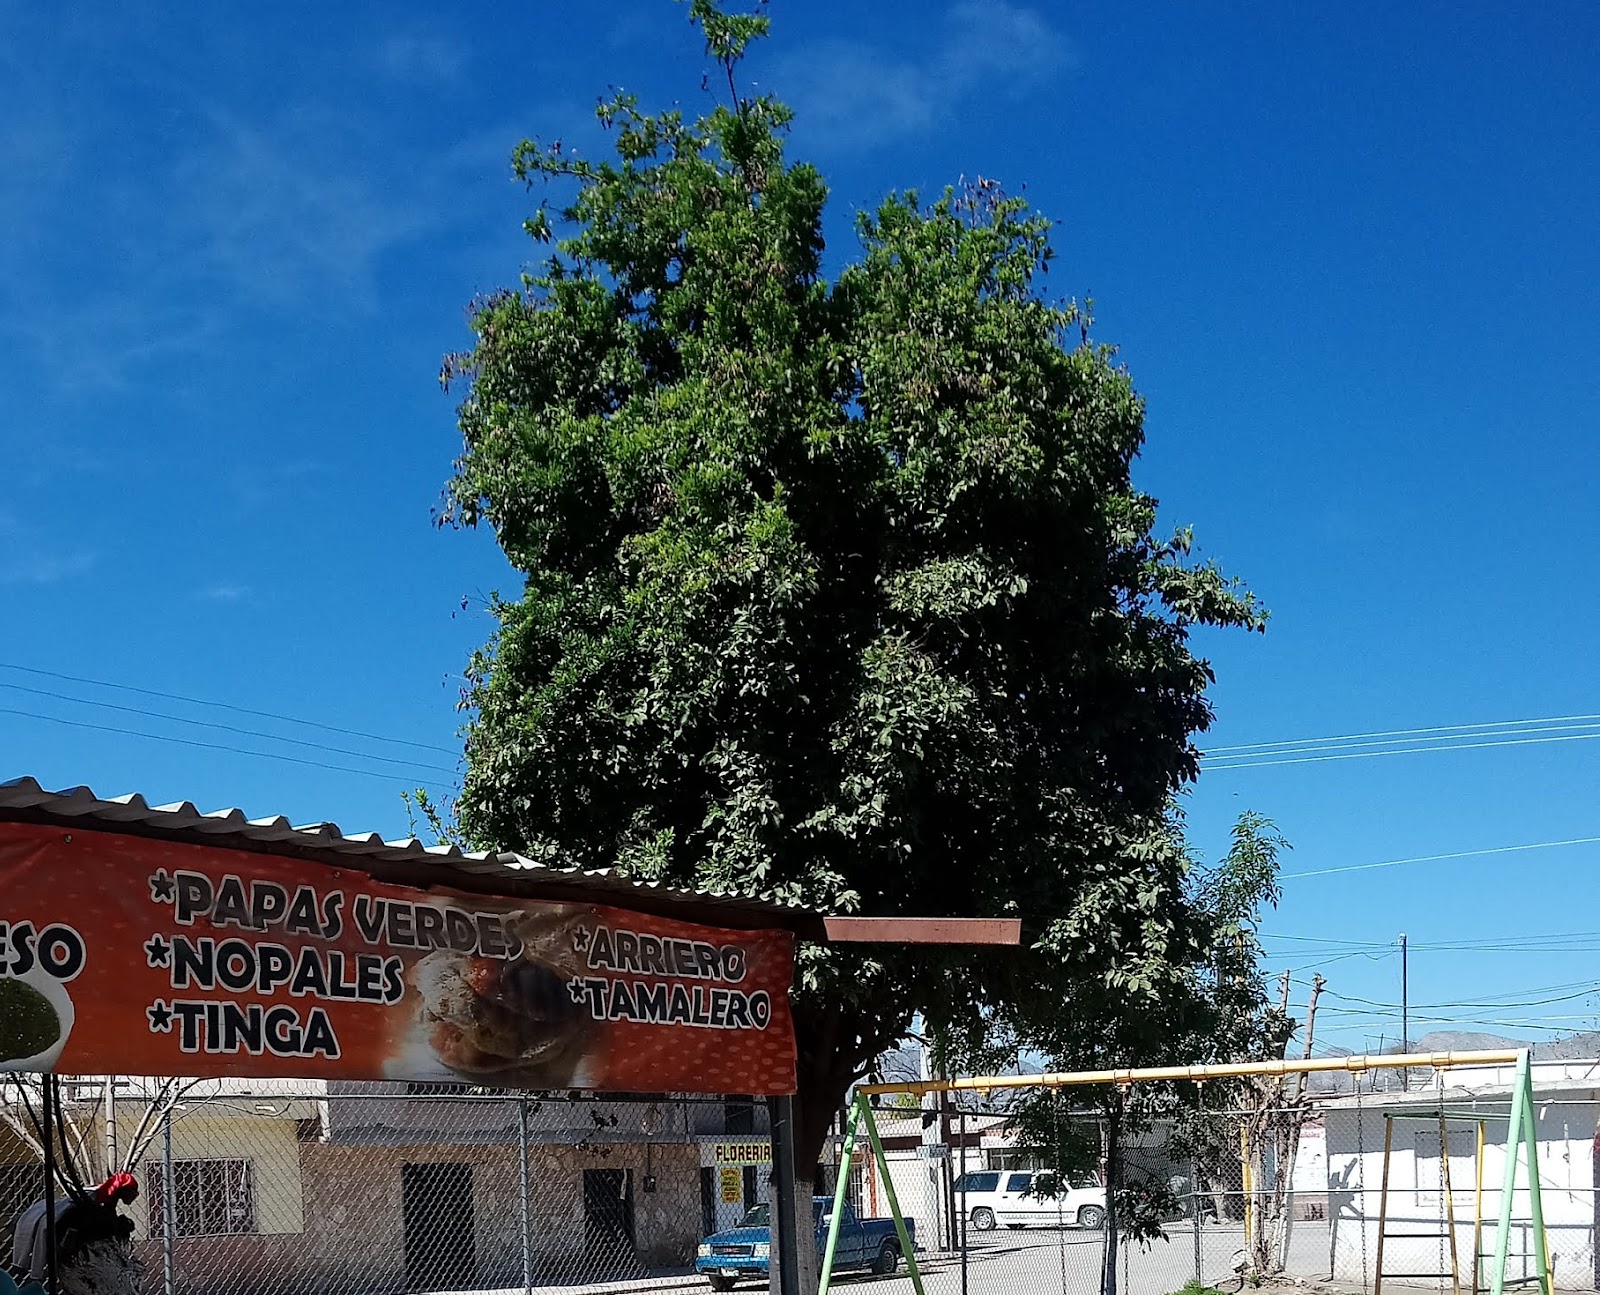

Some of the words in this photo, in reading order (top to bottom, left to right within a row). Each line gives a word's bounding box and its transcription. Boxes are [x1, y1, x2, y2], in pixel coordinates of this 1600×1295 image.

[173, 869, 344, 941] PAPAS
[353, 895, 530, 964] VERDES
[169, 934, 405, 1006] NOPALES
[586, 922, 747, 983] ARRIERO
[173, 998, 342, 1061] TINGA
[586, 976, 772, 1031] TAMALERO
